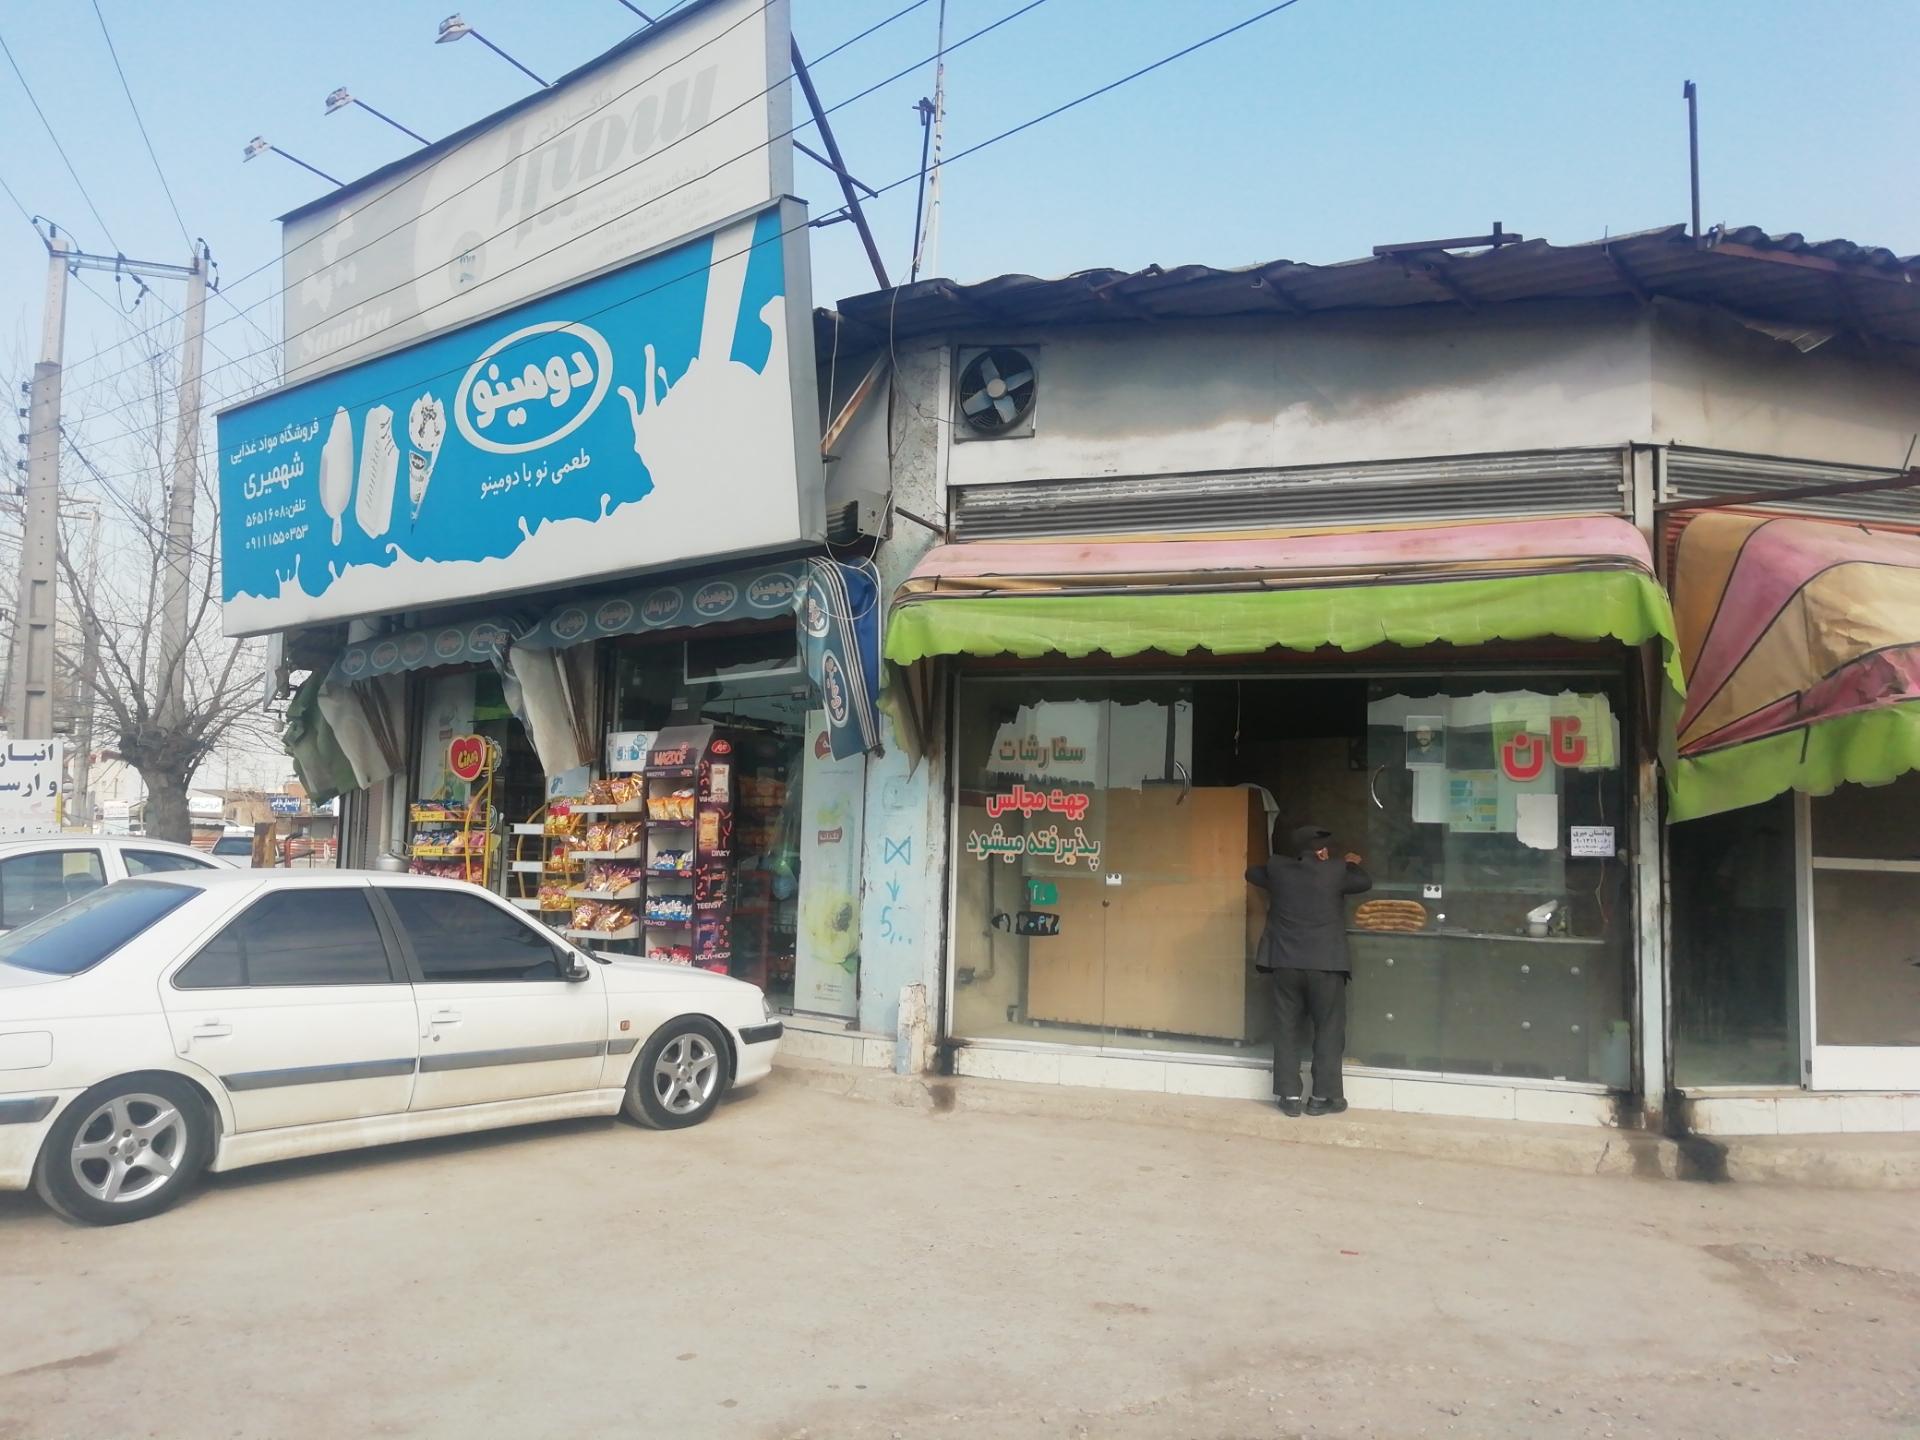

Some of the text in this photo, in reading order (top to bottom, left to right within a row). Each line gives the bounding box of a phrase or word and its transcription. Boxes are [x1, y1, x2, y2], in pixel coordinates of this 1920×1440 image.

[472, 351, 594, 429] دومینو
[230, 417, 319, 465] فروشگاه مواد غذایی
[243, 451, 304, 500] شهمیری
[480, 448, 591, 500] طعمی نو با دومینو
[751, 578, 794, 601] دومینو
[999, 734, 1087, 769] سفارشات
[1501, 715, 1588, 782] نان
[986, 784, 1090, 820] جهت مجالس
[966, 823, 1101, 871] پذیرفته میشود
